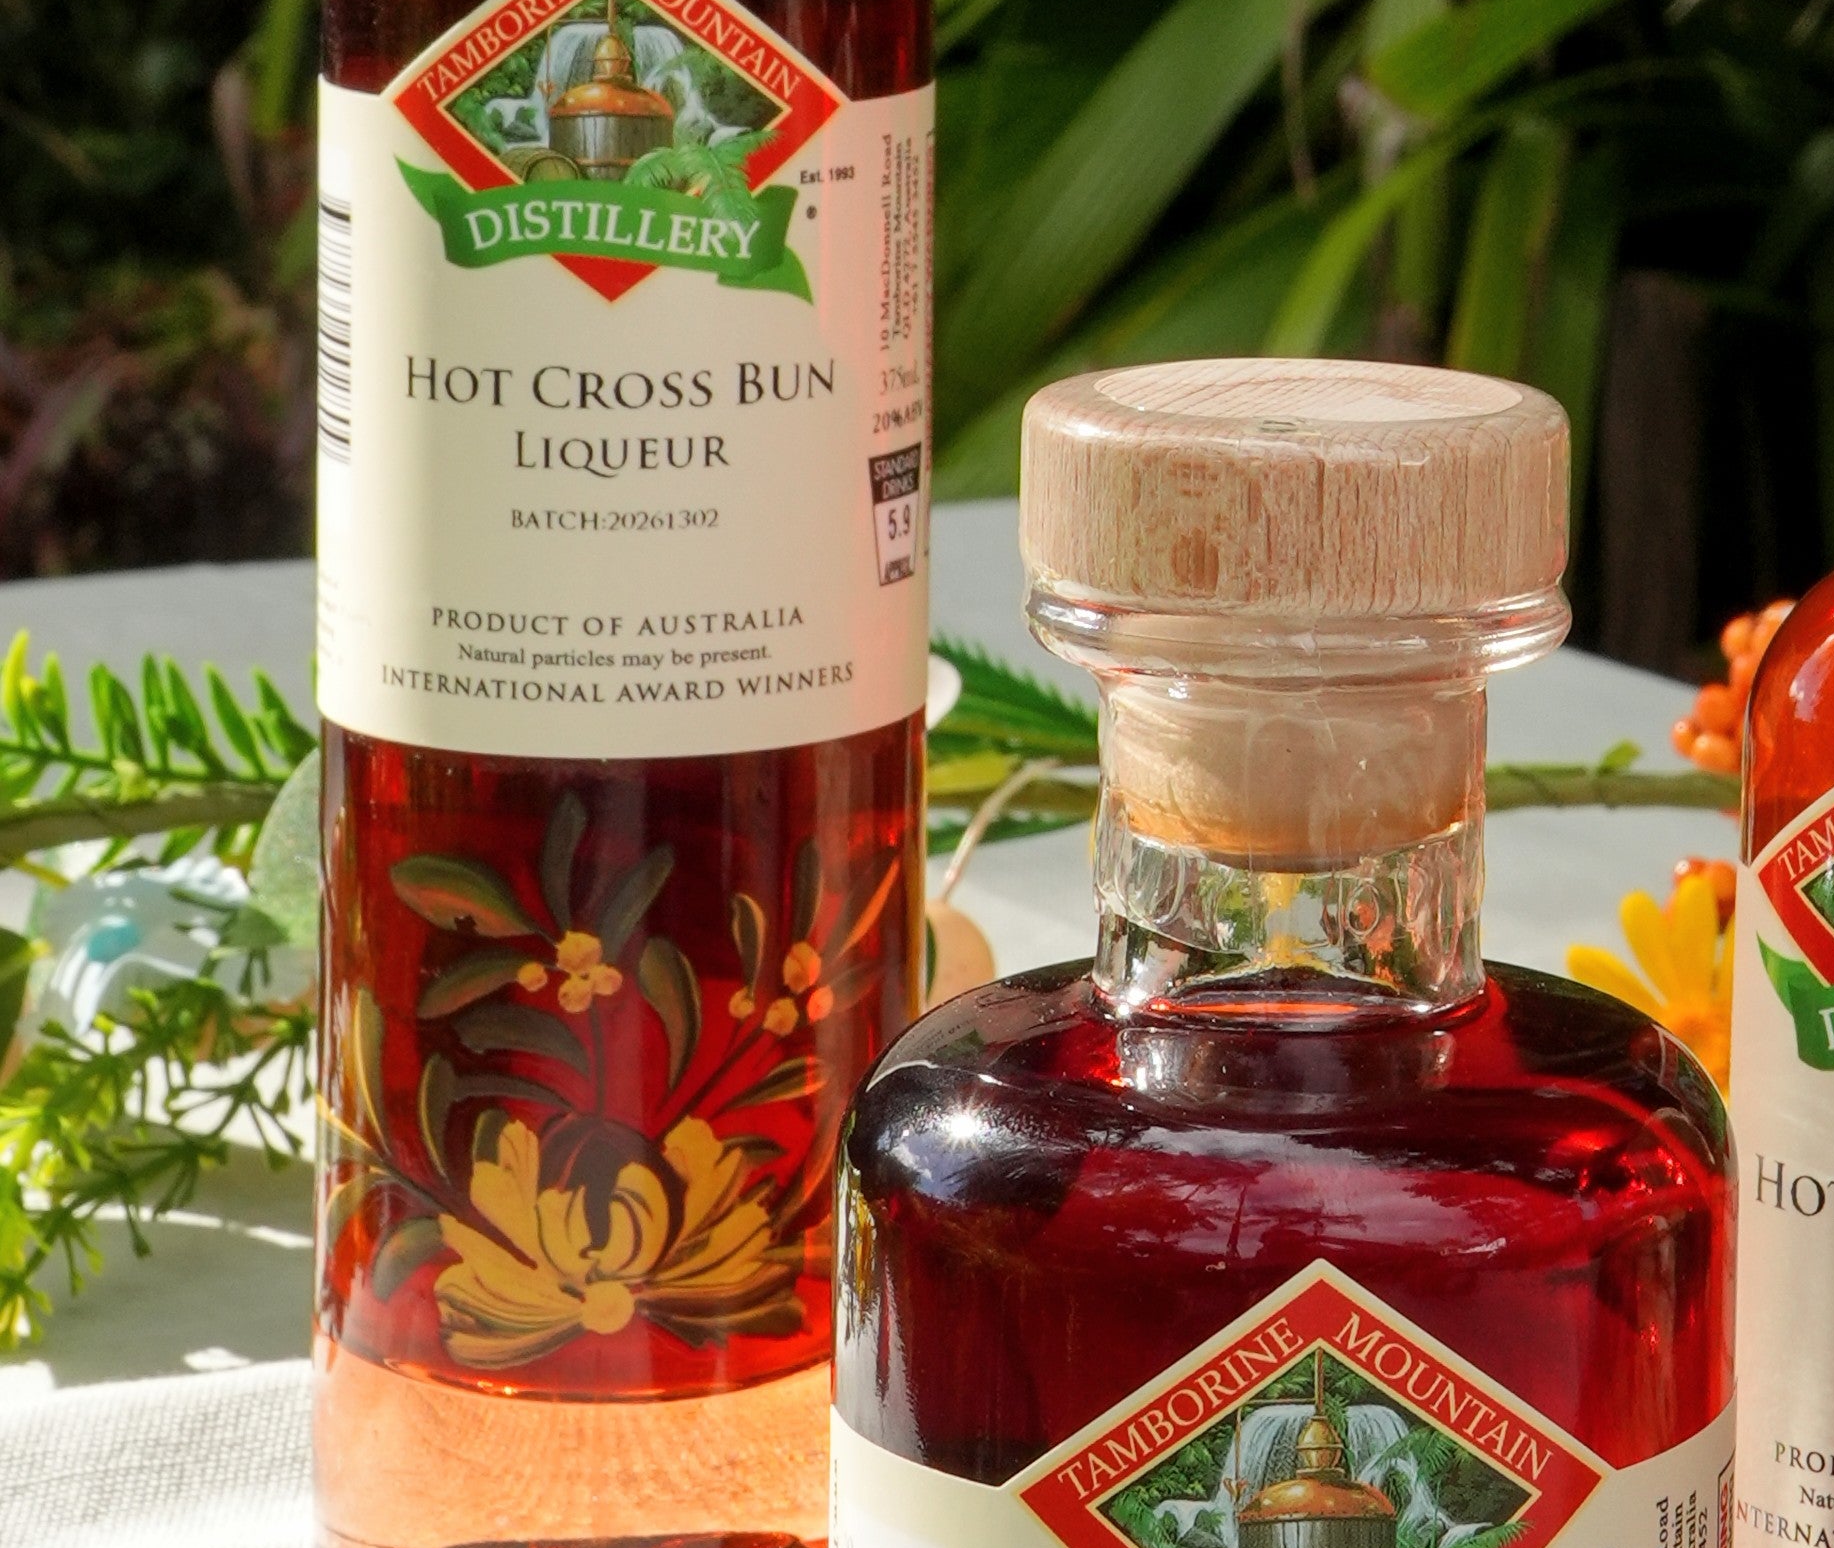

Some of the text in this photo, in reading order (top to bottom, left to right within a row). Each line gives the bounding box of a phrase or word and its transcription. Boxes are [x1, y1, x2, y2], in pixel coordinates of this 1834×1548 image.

[465, 200, 762, 260] DISTILLERY
[431, 606, 805, 637] PRODUCT OF AUSTRALIA
[457, 643, 773, 670] Natural particles may be present.
[380, 661, 854, 704] INTERNATIONAL AWARD WINNERS
[1056, 1310, 1555, 1501] TAMBORINE MOUNTAIN
